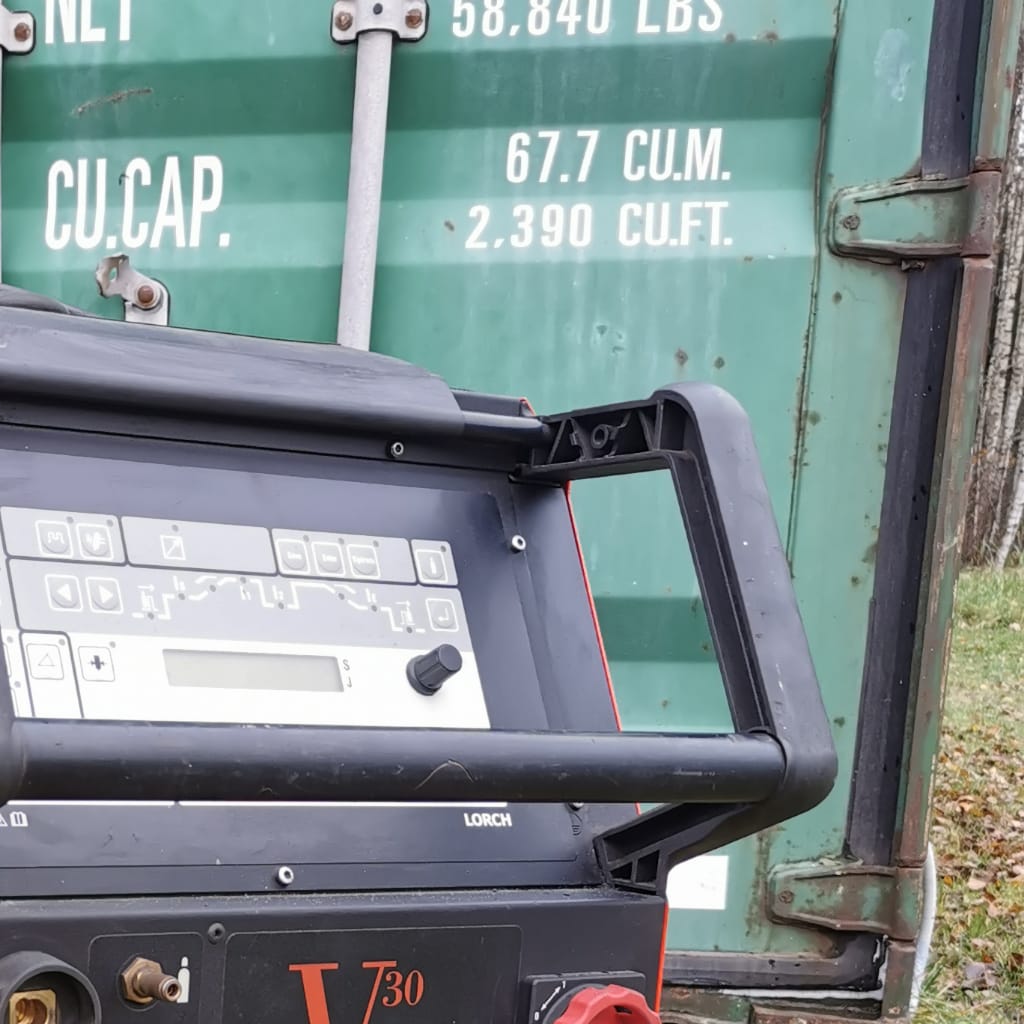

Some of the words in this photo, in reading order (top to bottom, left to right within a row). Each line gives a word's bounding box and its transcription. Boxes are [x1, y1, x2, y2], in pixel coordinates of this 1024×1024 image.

[451, 0, 611, 38] 58,840
[636, 0, 723, 34] LBS
[506, 130, 600, 184] 67.7
[622, 127, 731, 182] CU.M.
[44, 155, 232, 251] CU.CAP.
[464, 204, 594, 249] 2,390
[618, 200, 734, 247] CU.FT.
[463, 812, 513, 828] LORCH
